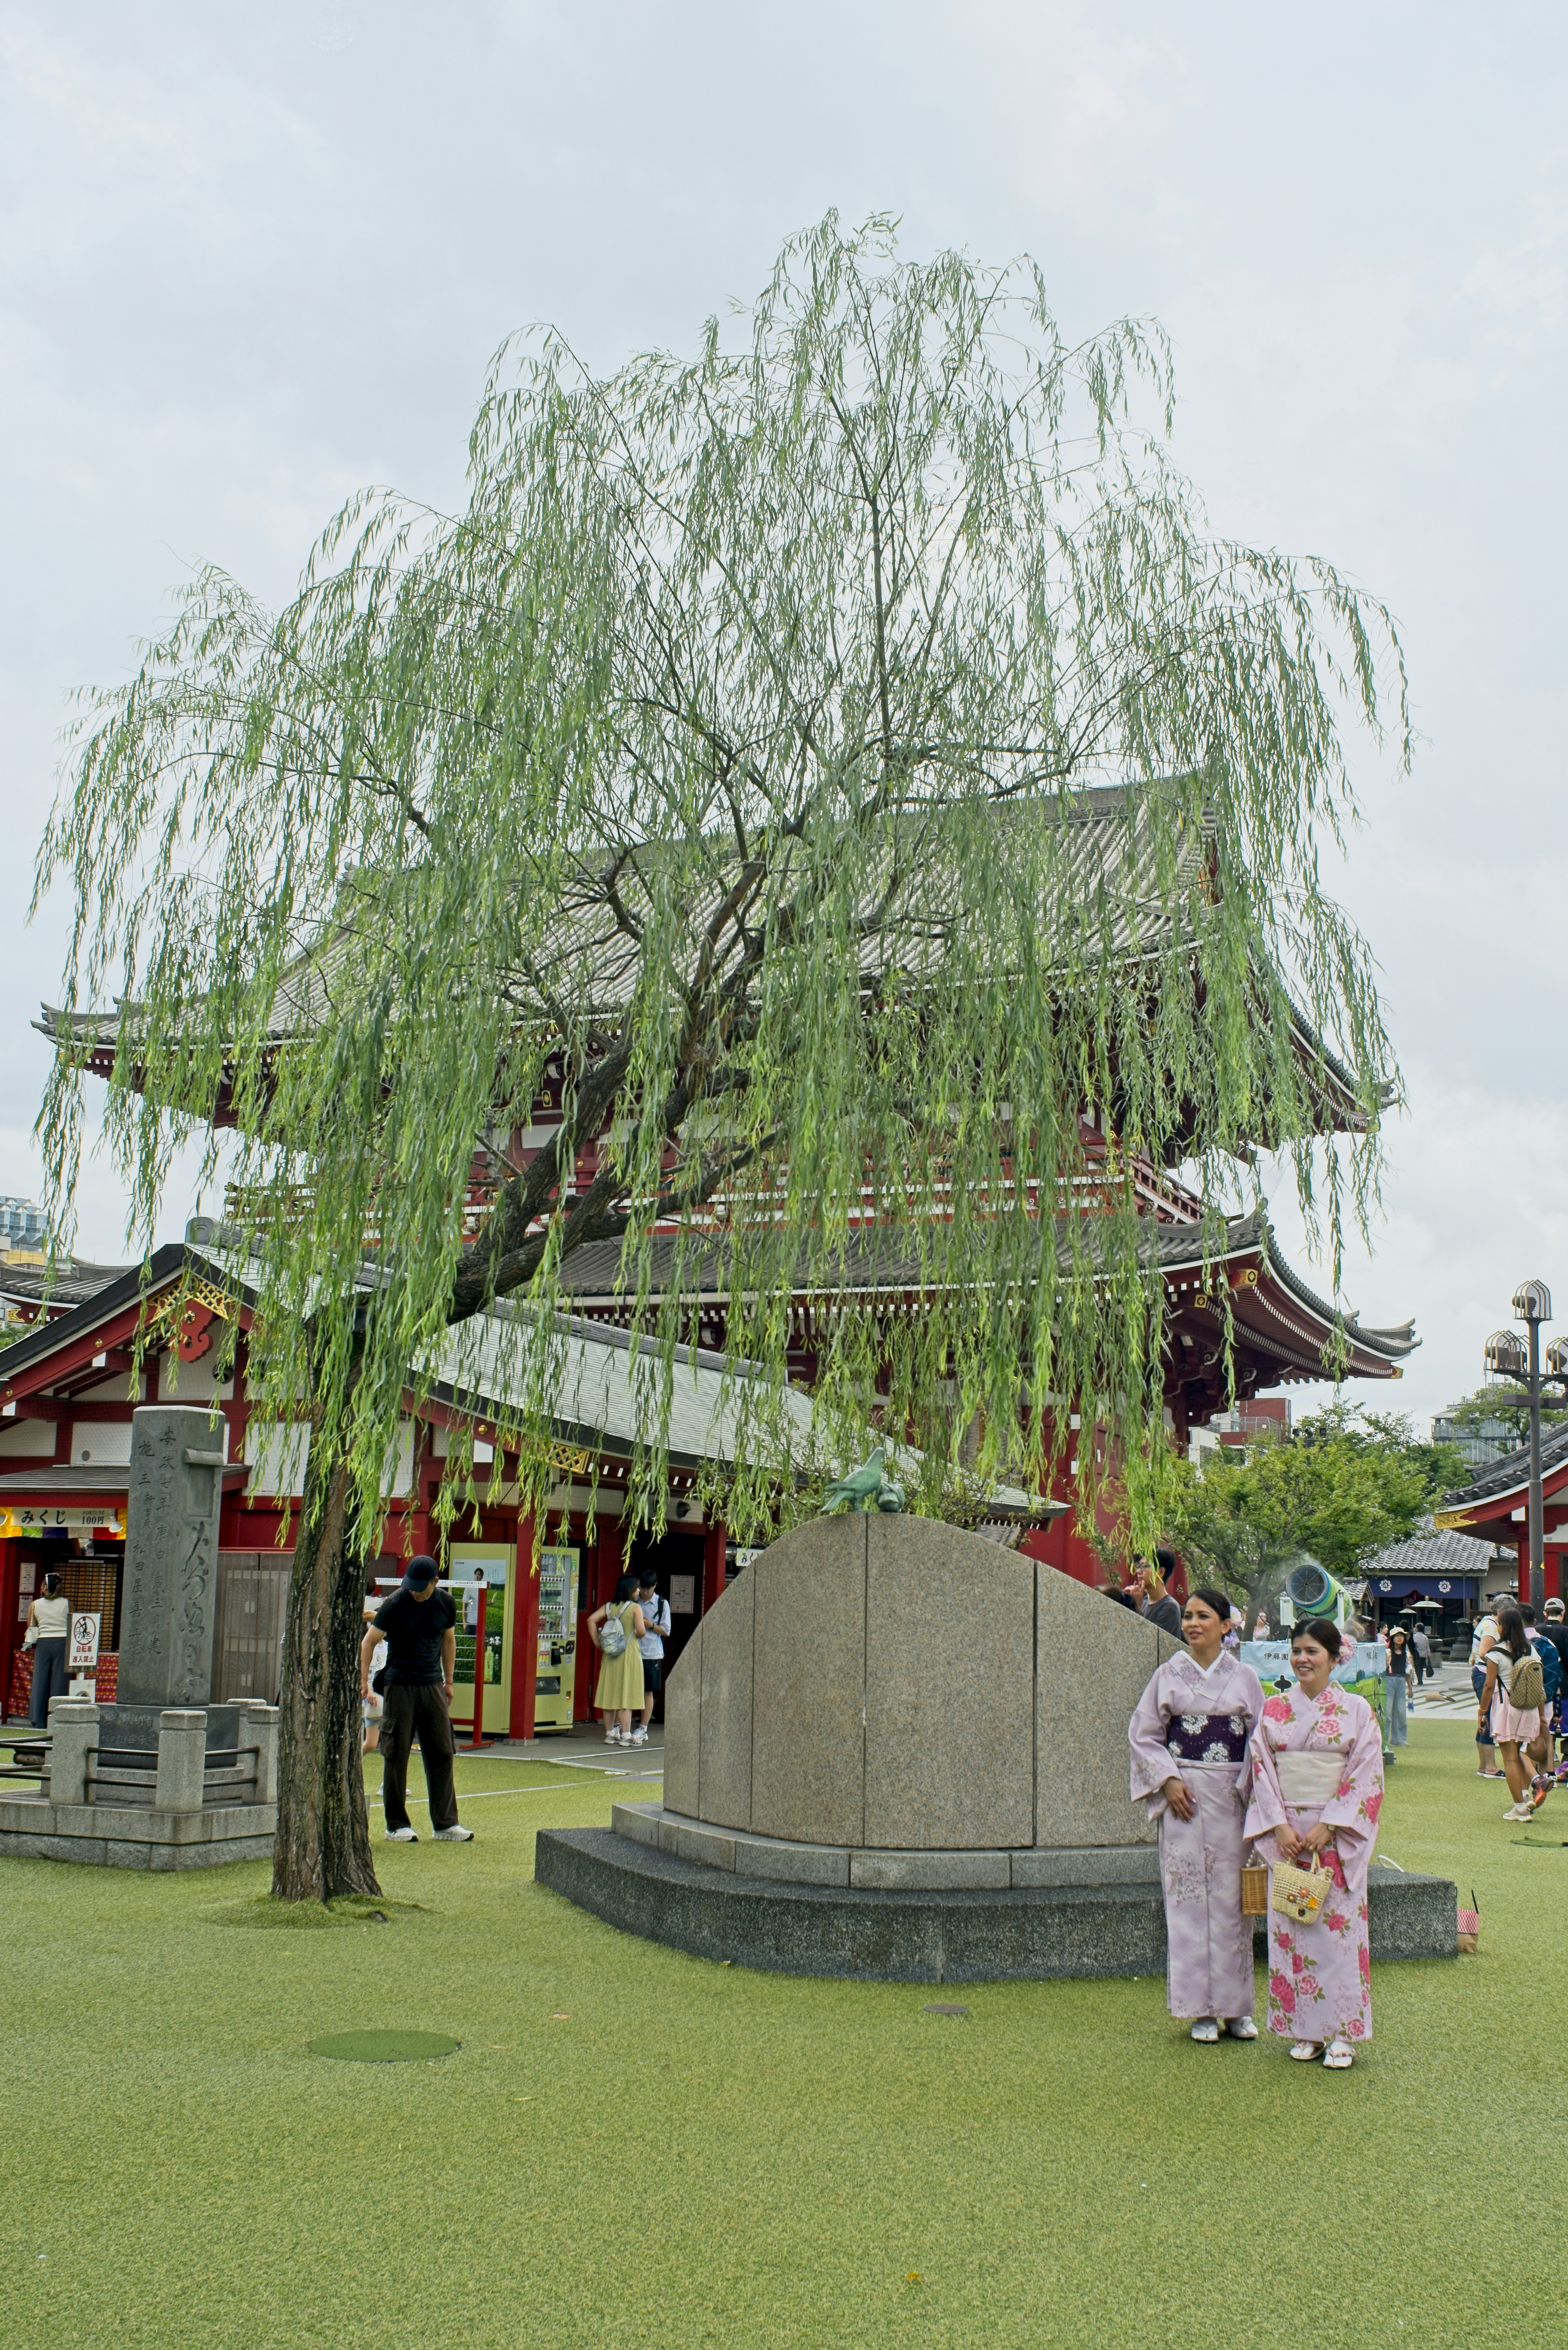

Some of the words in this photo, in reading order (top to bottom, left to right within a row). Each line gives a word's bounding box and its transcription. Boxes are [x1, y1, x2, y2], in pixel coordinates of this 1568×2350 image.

[21, 1509, 66, 1525] みくじ
[81, 1516, 104, 1524] 100円
[1263, 1652, 1289, 1660] 伊藤園
